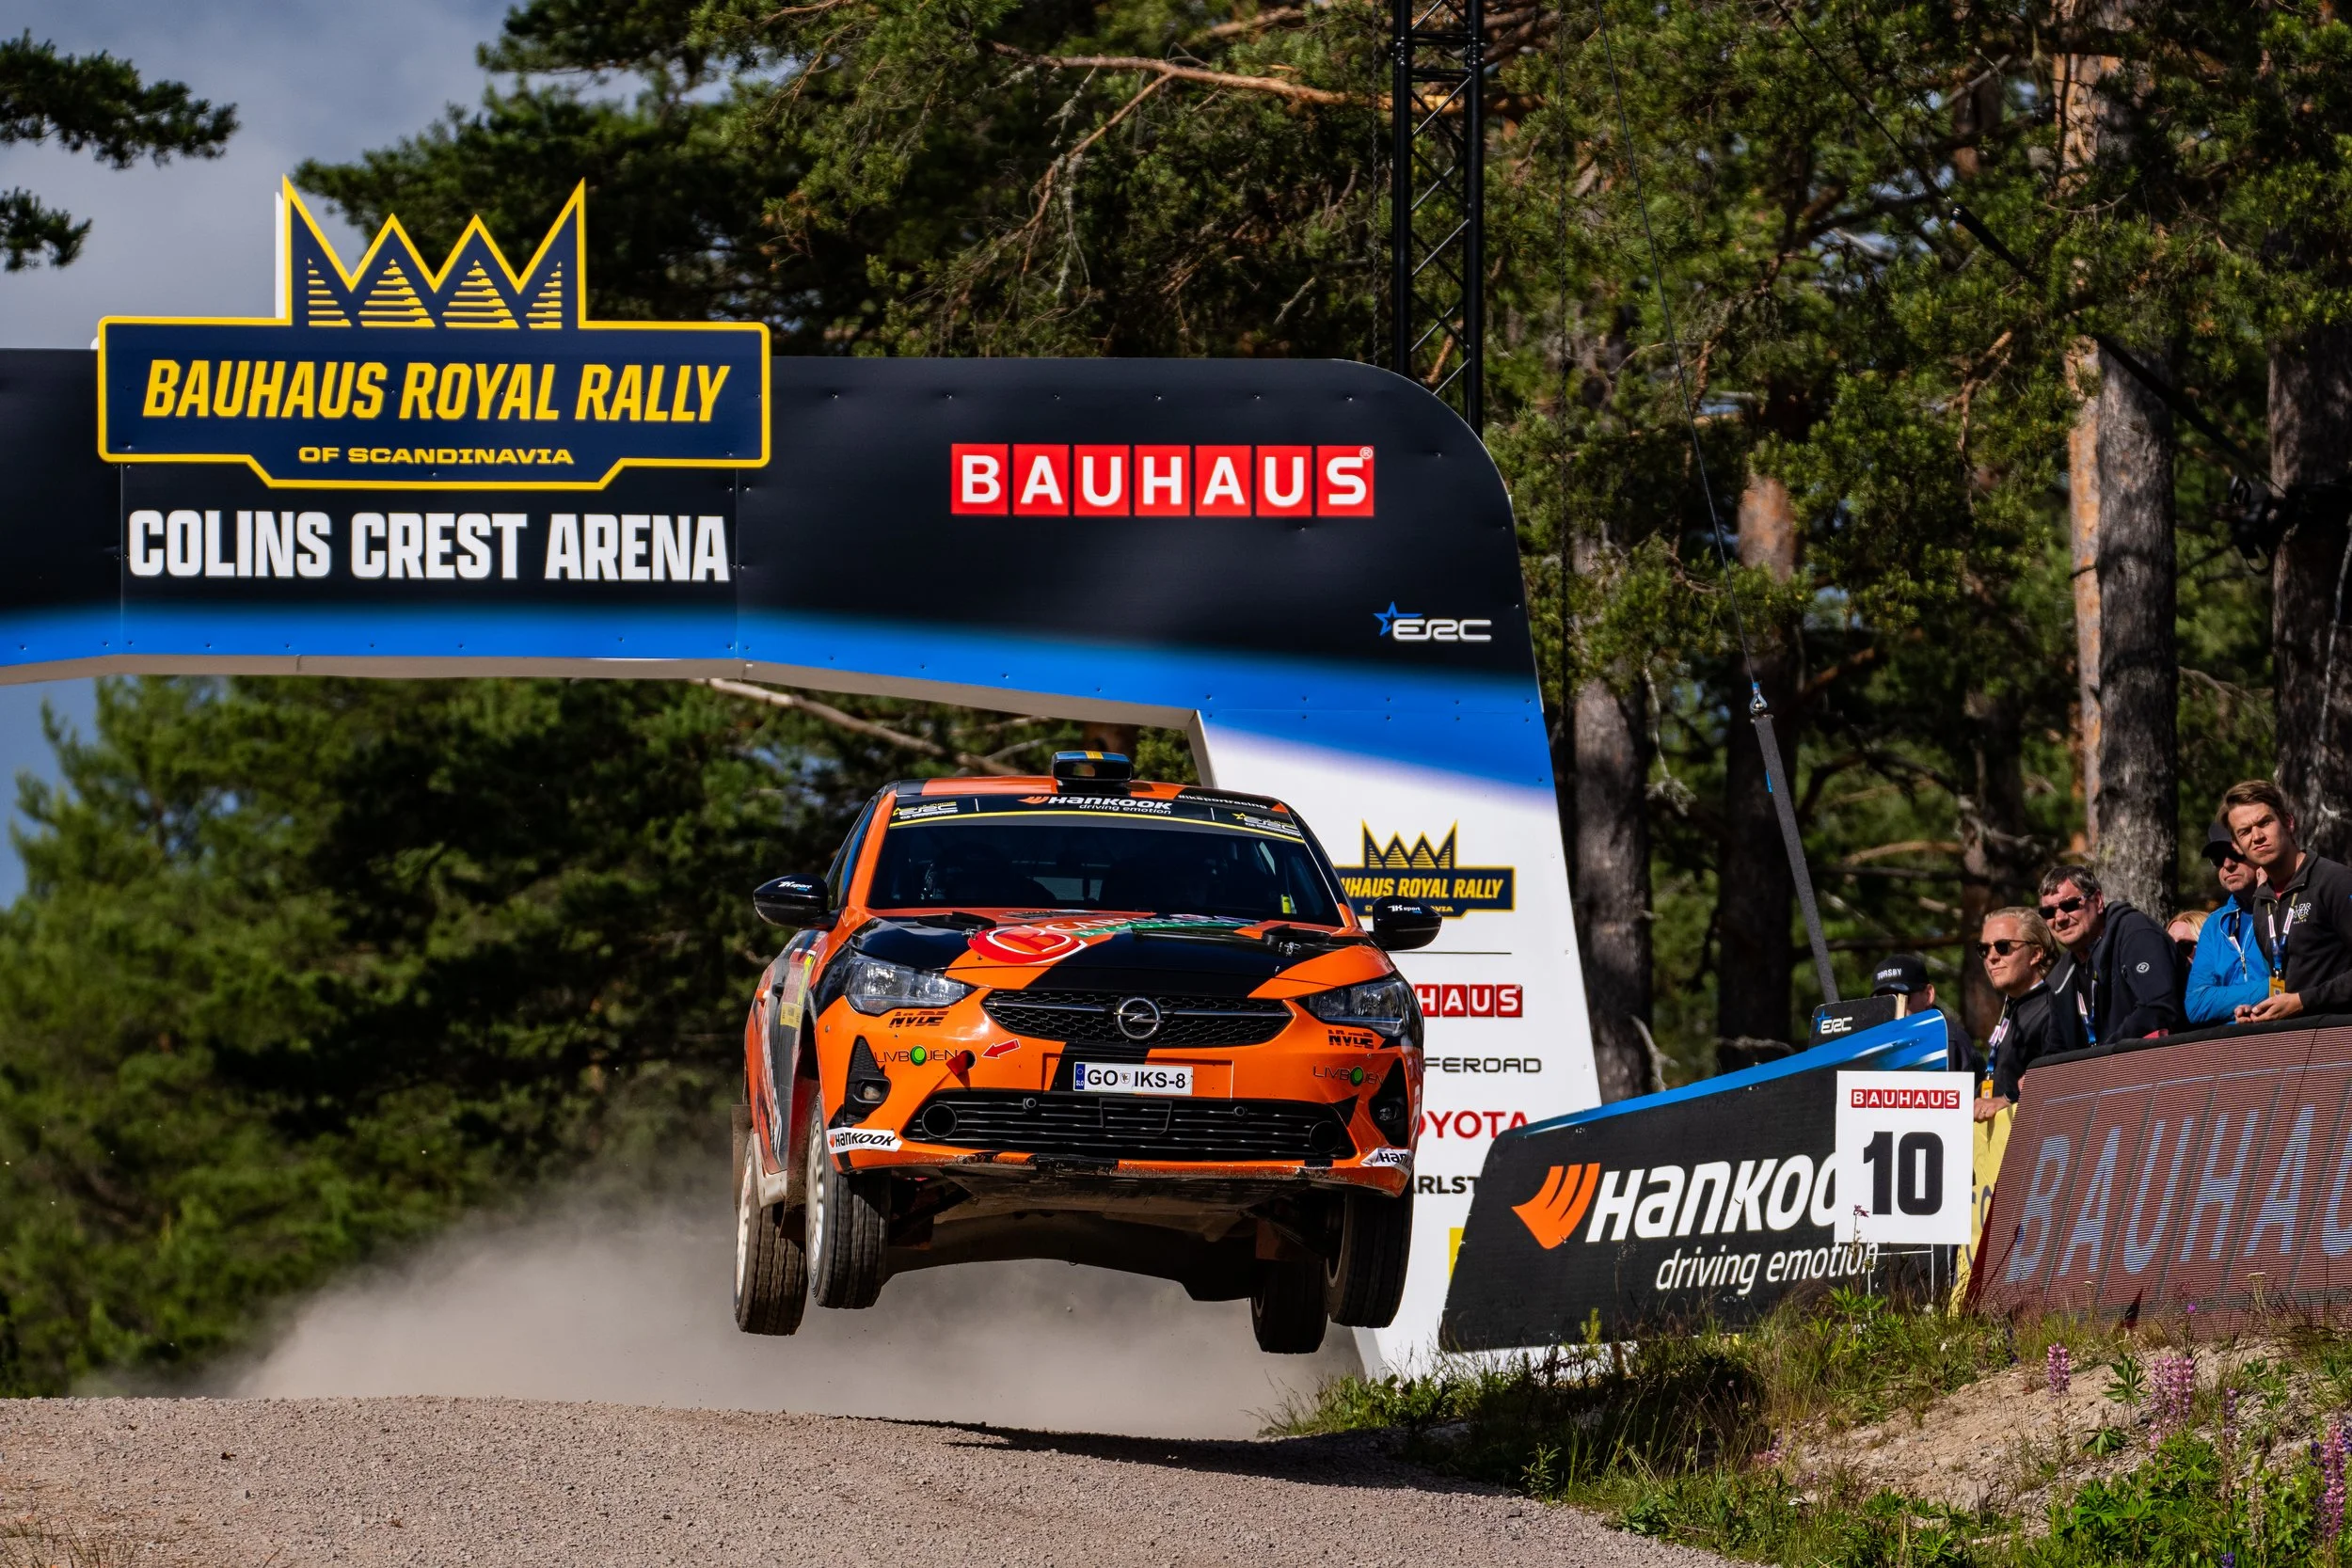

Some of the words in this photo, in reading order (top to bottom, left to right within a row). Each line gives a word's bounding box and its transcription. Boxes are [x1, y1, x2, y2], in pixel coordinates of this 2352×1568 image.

[143, 359, 387, 419] BAUHAUS
[400, 363, 559, 420] ROYAL
[575, 364, 730, 422] RALLY
[298, 447, 342, 462] OF
[348, 447, 574, 465] SCANDINAVIA
[129, 510, 330, 578] COLINS
[350, 513, 528, 579] CREST
[545, 515, 730, 582] ARENA
[1392, 619, 1492, 641] ERC
[1079, 803, 1119, 812] driving
[1123, 805, 1171, 815] emotion
[1398, 879, 1449, 898] ROYAL
[1454, 879, 1503, 898] RALLY
[1877, 968, 1902, 980] TORSBY
[1416, 988, 1518, 1012] HAUS
[1820, 1017, 1852, 1035] ERC
[1423, 1057, 1542, 1073] FEROAD
[1088, 1069, 1118, 1085] GO
[1135, 1071, 1185, 1088] IKS-8
[1853, 1091, 1958, 1105] BAUHAUS
[1419, 1111, 1528, 1139] YOTA
[1863, 1132, 1944, 1215] 10
[1656, 1244, 1761, 1295] driving
[1766, 1243, 1878, 1282] emotion
